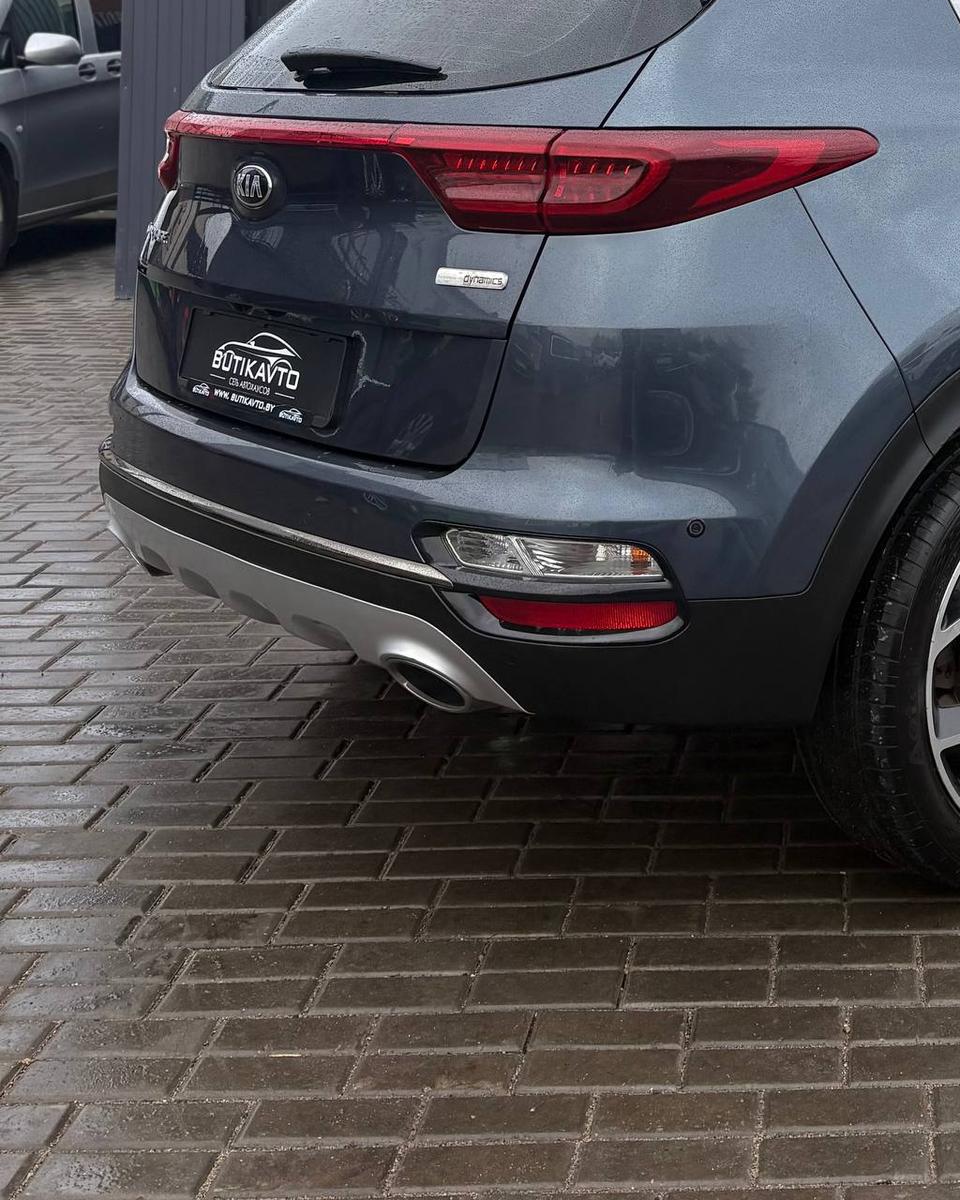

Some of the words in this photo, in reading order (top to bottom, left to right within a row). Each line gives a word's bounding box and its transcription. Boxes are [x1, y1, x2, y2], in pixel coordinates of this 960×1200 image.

[237, 173, 263, 198] KIA
[463, 275, 503, 287] dynamics
[211, 350, 300, 390] BUTIKAVTO
